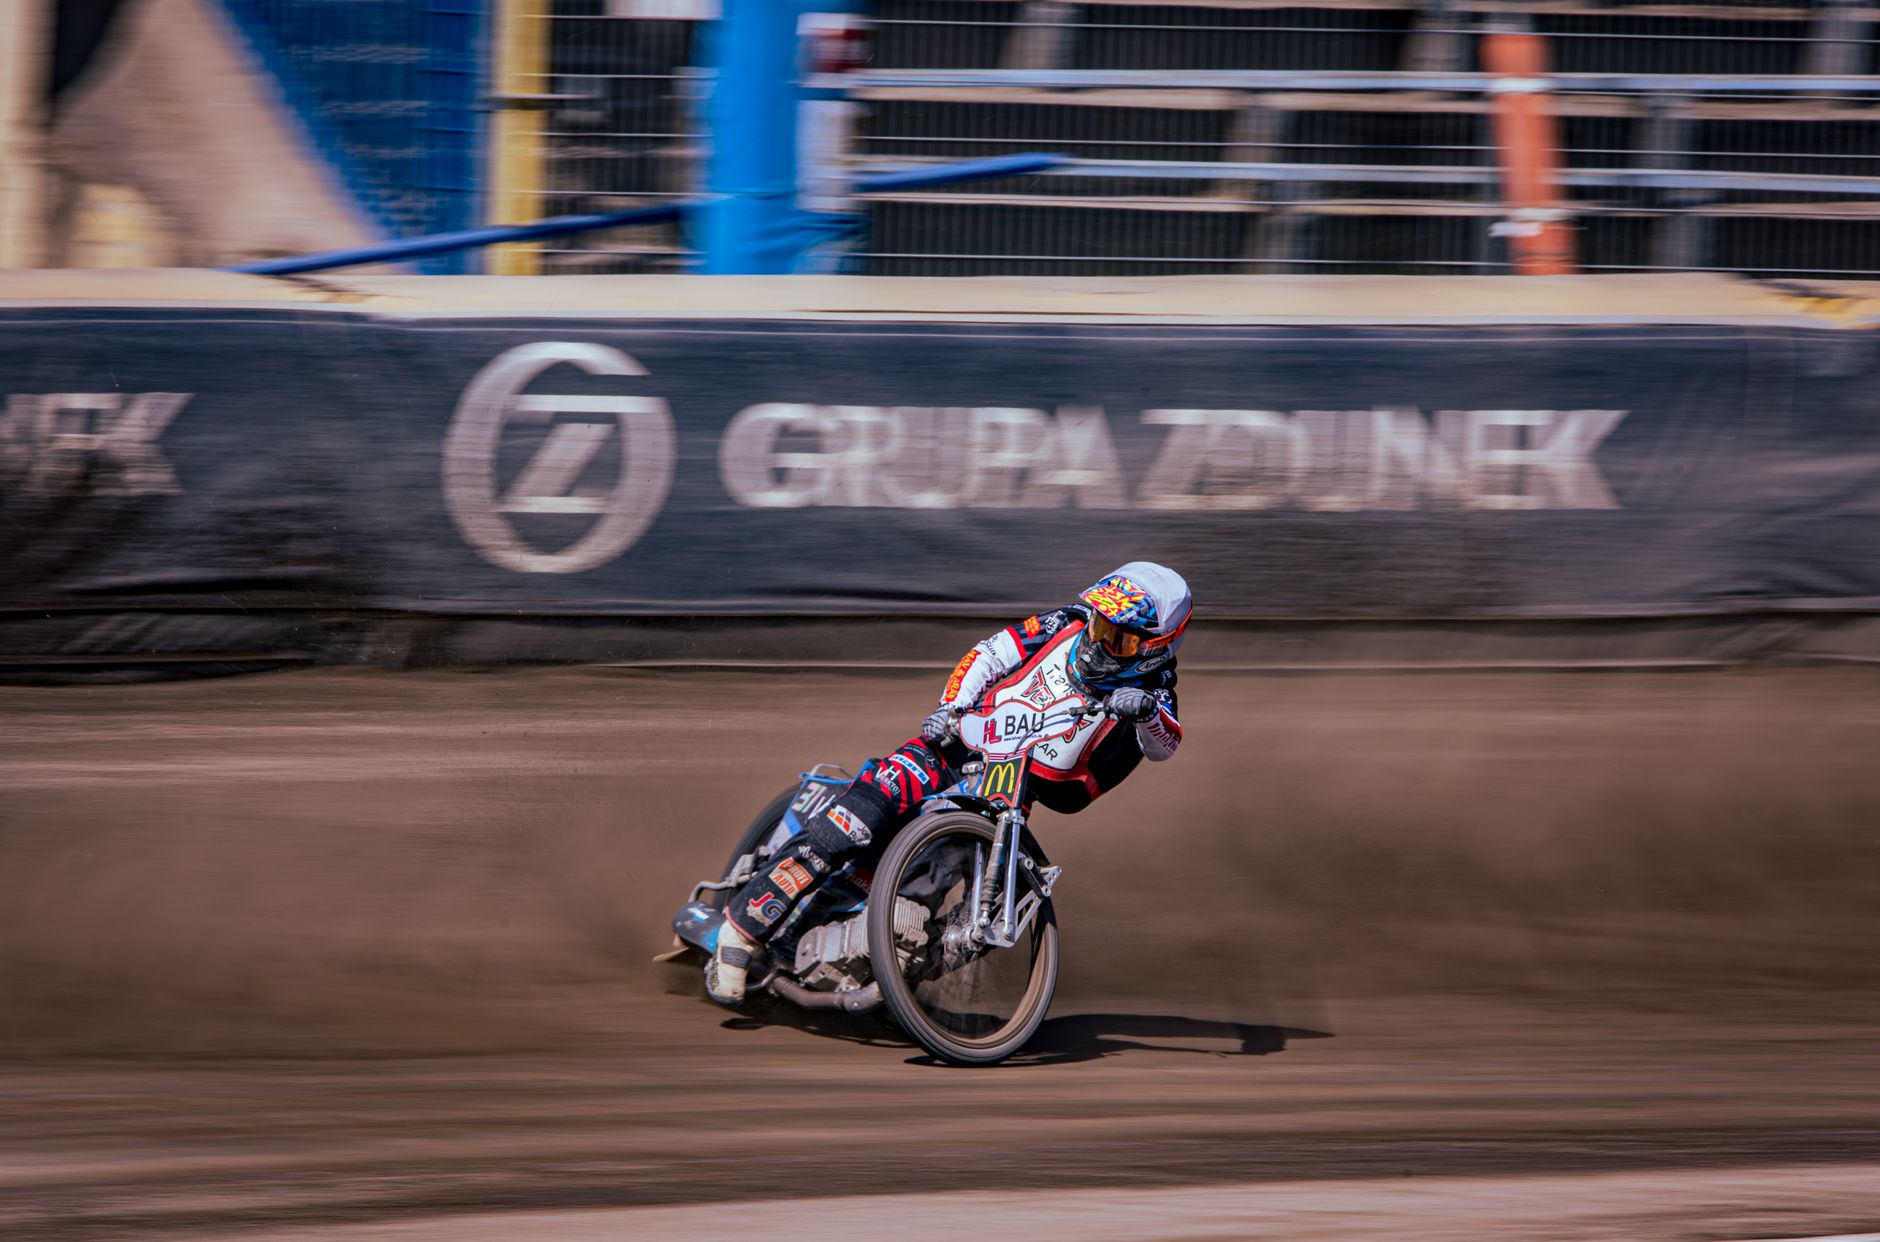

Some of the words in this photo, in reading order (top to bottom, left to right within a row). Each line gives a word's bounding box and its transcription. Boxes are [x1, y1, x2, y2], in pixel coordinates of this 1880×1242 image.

[718, 402, 1128, 509] GRUPA
[1004, 712, 1045, 736] BAU
[773, 873, 796, 895] AUTO
